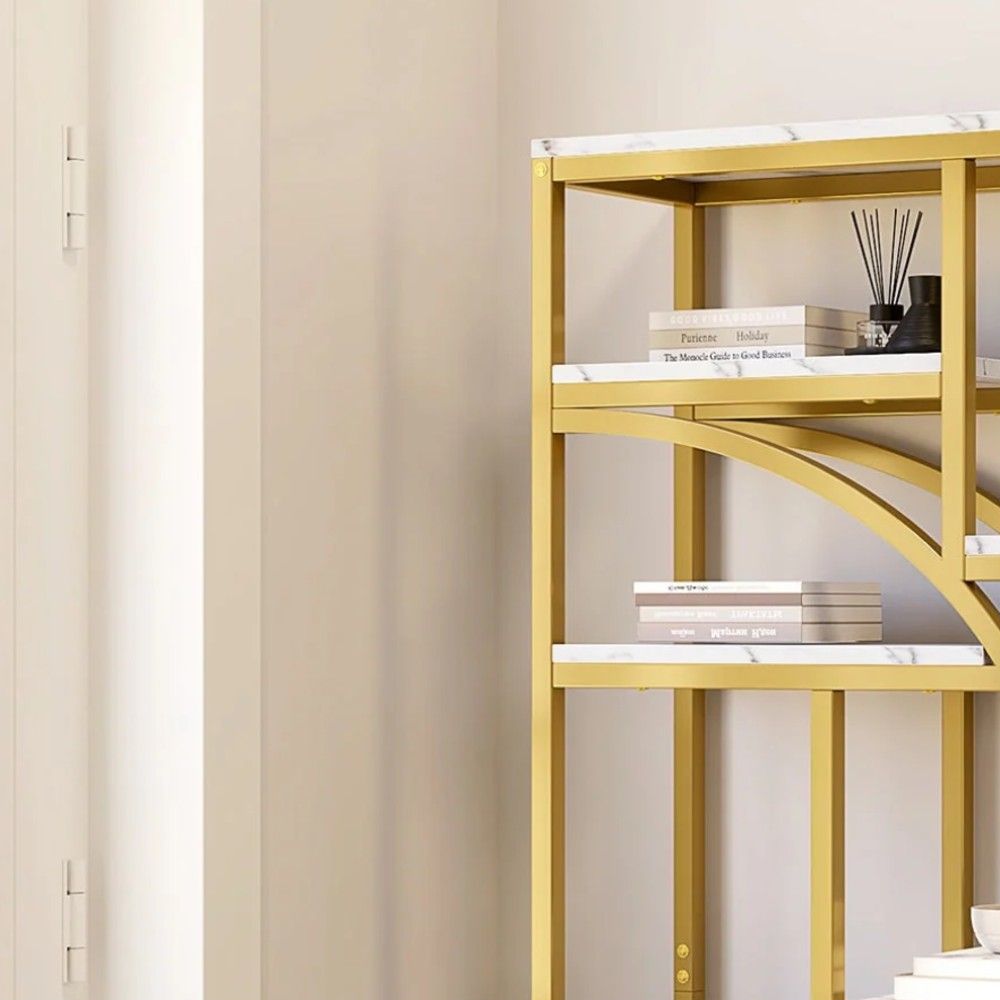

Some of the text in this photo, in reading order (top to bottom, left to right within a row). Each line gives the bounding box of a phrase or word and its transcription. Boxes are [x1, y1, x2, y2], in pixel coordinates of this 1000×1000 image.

[736, 330, 769, 344] Holiday
[664, 350, 792, 363] The Monocle Guide to Good Business
